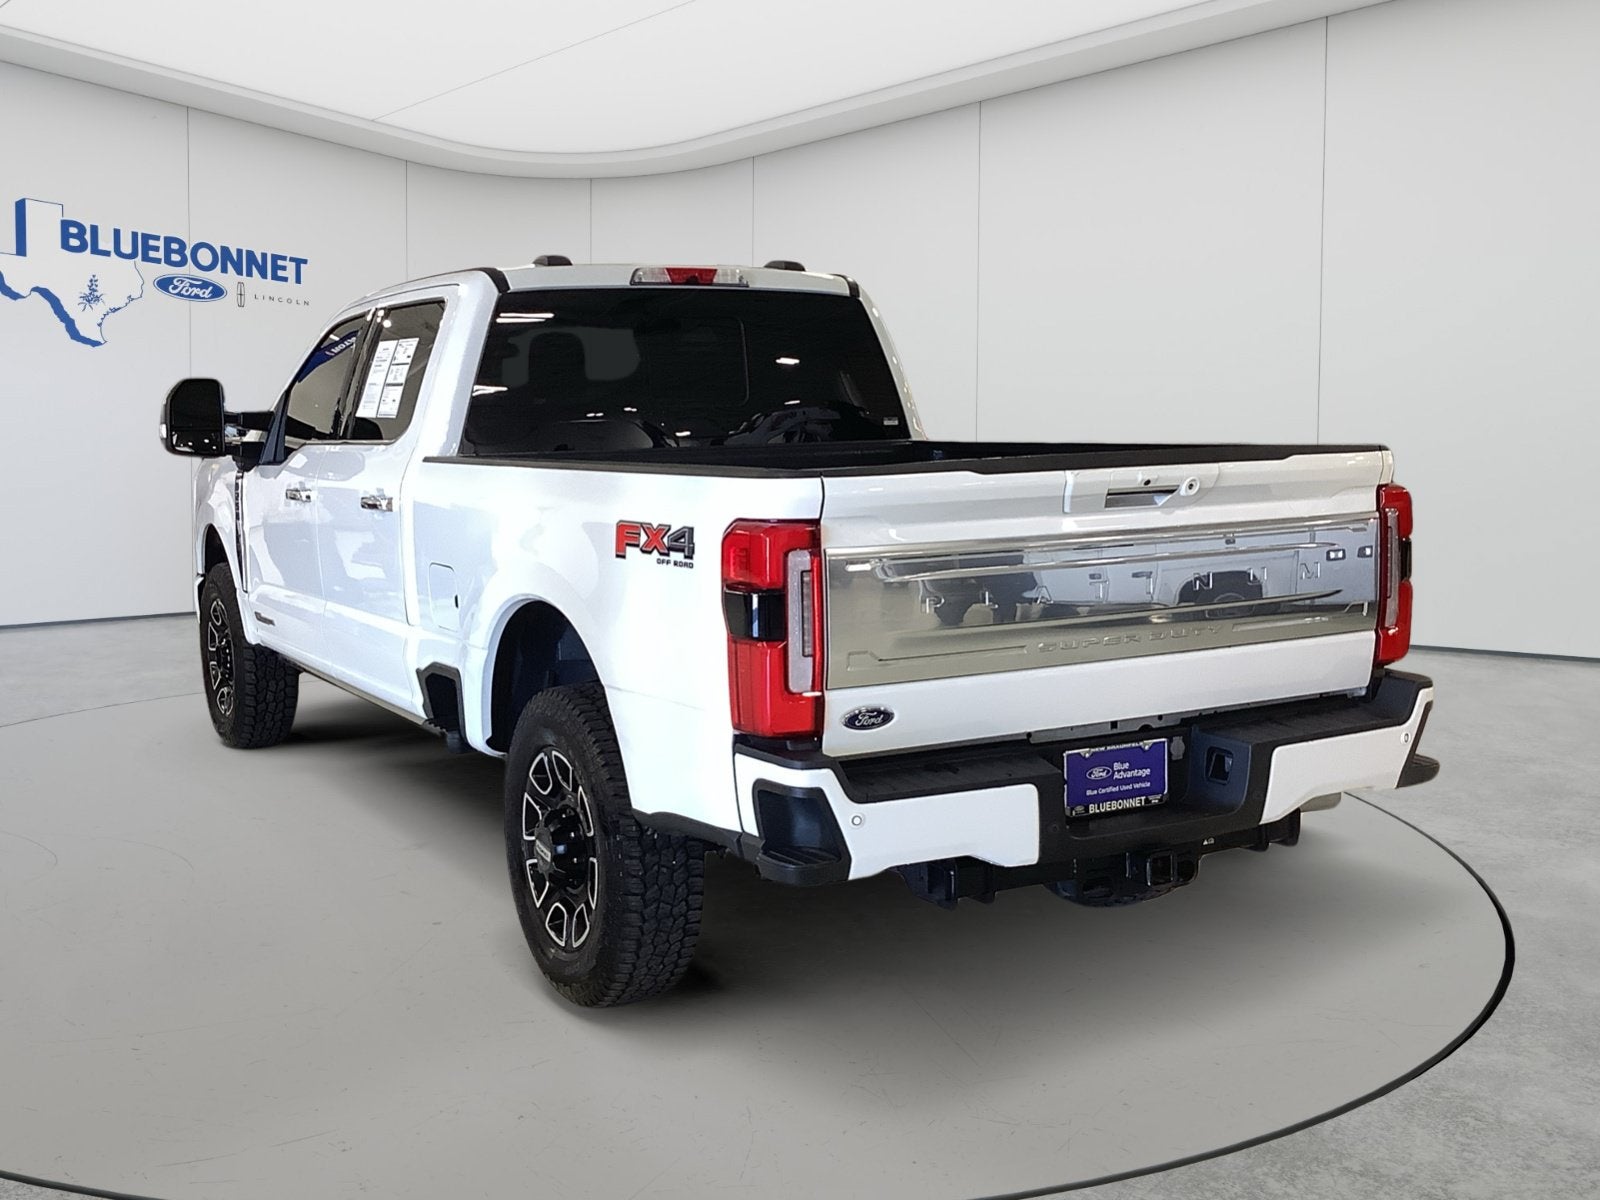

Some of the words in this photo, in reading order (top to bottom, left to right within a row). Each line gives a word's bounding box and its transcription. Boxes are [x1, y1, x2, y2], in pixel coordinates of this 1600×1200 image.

[60, 218, 308, 285] BLUEBONNET
[168, 277, 213, 299] Ford
[254, 294, 310, 306] LINCOLN
[615, 519, 695, 560] FX4
[656, 558, 671, 566] OFF
[673, 560, 694, 569] ROAD
[920, 561, 1321, 615] PLATINUM
[1037, 633, 1142, 652] SUPER
[1150, 624, 1222, 642] DUTY
[855, 711, 884, 726] Ford
[1113, 762, 1130, 771] Blue
[1113, 768, 1151, 780] Advantage
[1098, 786, 1119, 794] Certified
[1089, 796, 1147, 814] BLUEBONNET
